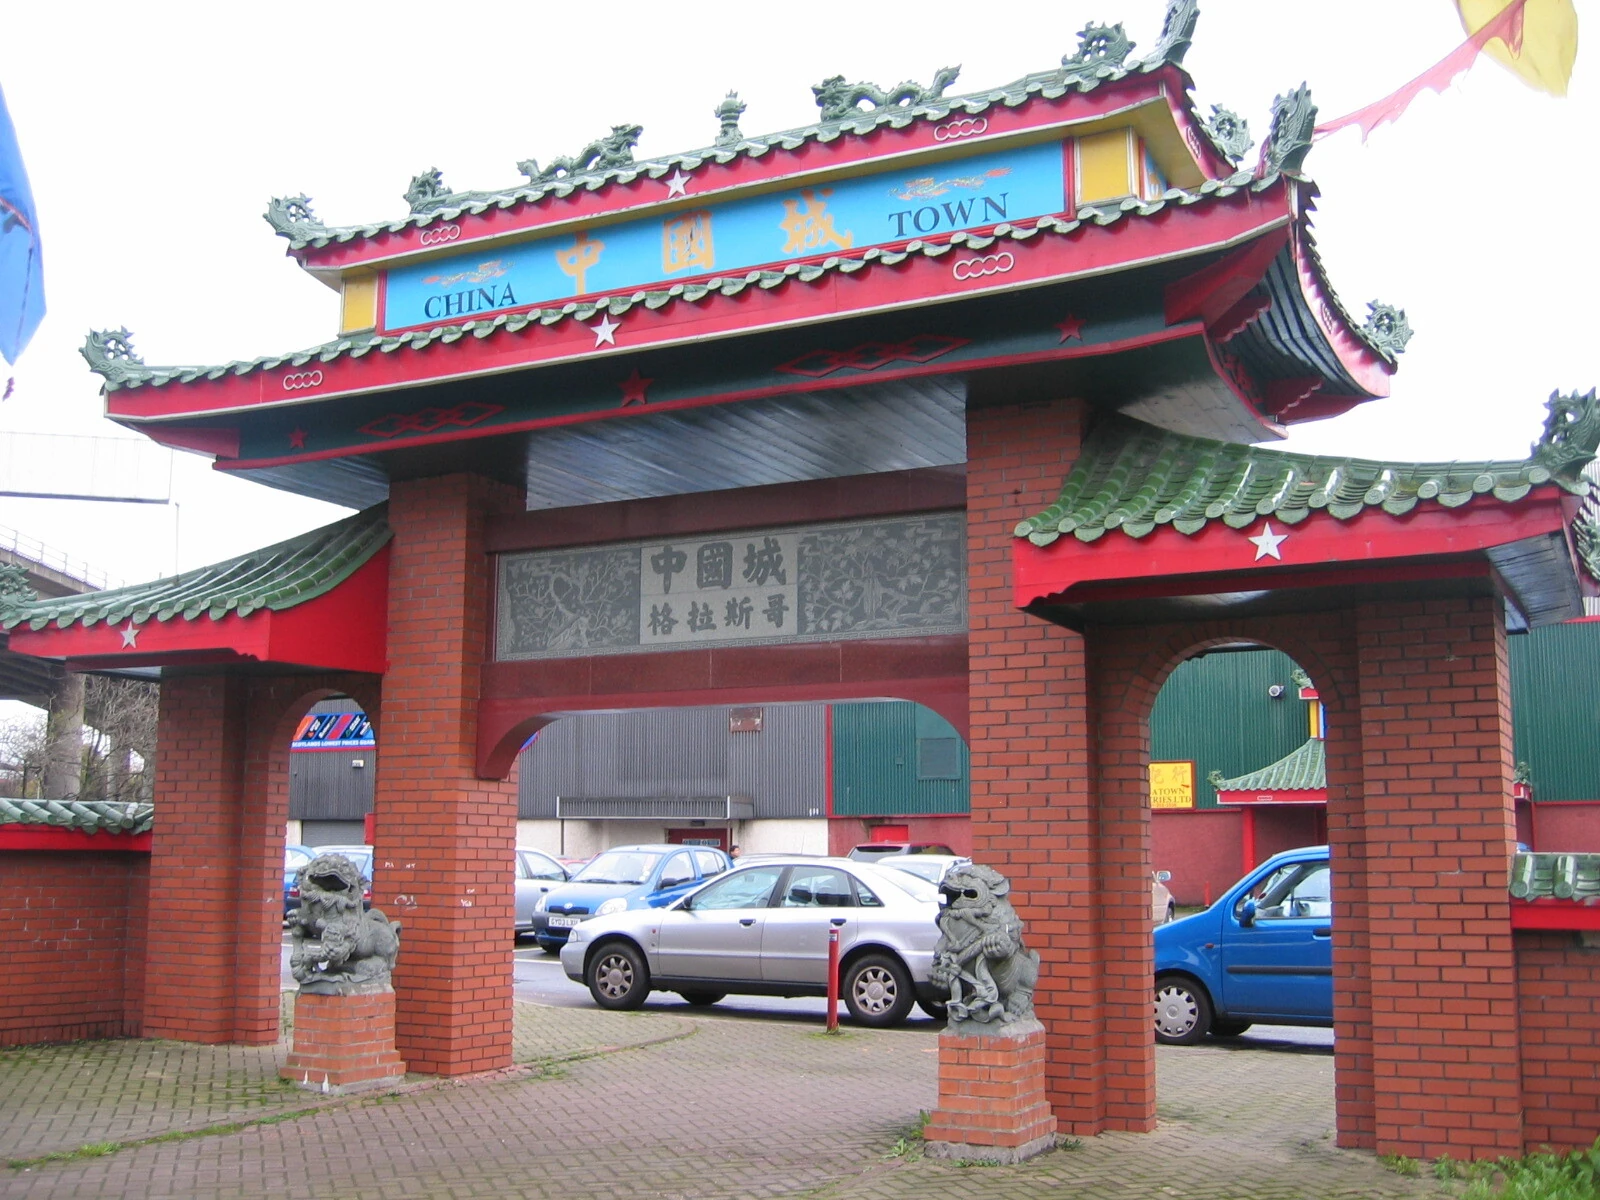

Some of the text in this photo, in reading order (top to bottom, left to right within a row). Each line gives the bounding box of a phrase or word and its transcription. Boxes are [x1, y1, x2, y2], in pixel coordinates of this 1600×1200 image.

[424, 192, 1008, 319] CHINA TOWN
[556, 187, 853, 296] 中國城
[650, 536, 787, 594] 中國城
[648, 593, 789, 636] 格拉斯哥
